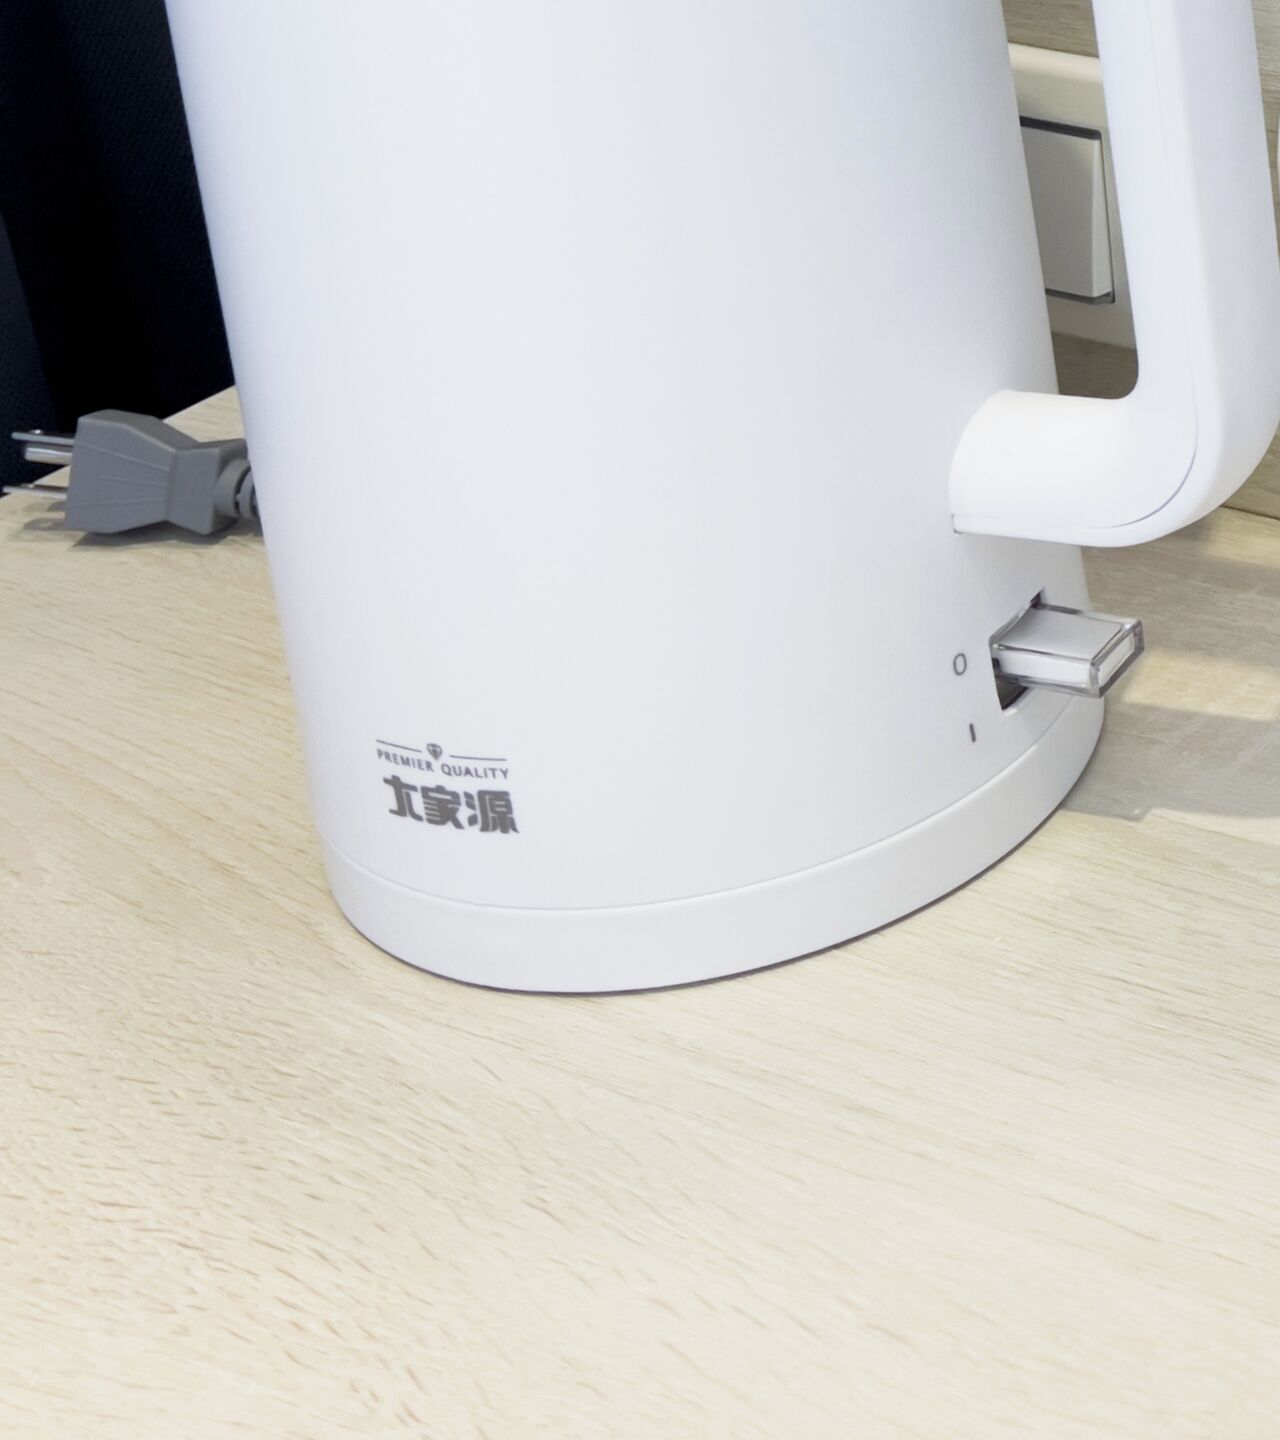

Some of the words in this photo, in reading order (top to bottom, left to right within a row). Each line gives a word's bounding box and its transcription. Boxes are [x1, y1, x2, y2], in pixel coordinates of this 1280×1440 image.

[376, 747, 435, 773] PREMIER
[440, 763, 510, 780] QUALITY
[382, 773, 520, 835] 大家源
